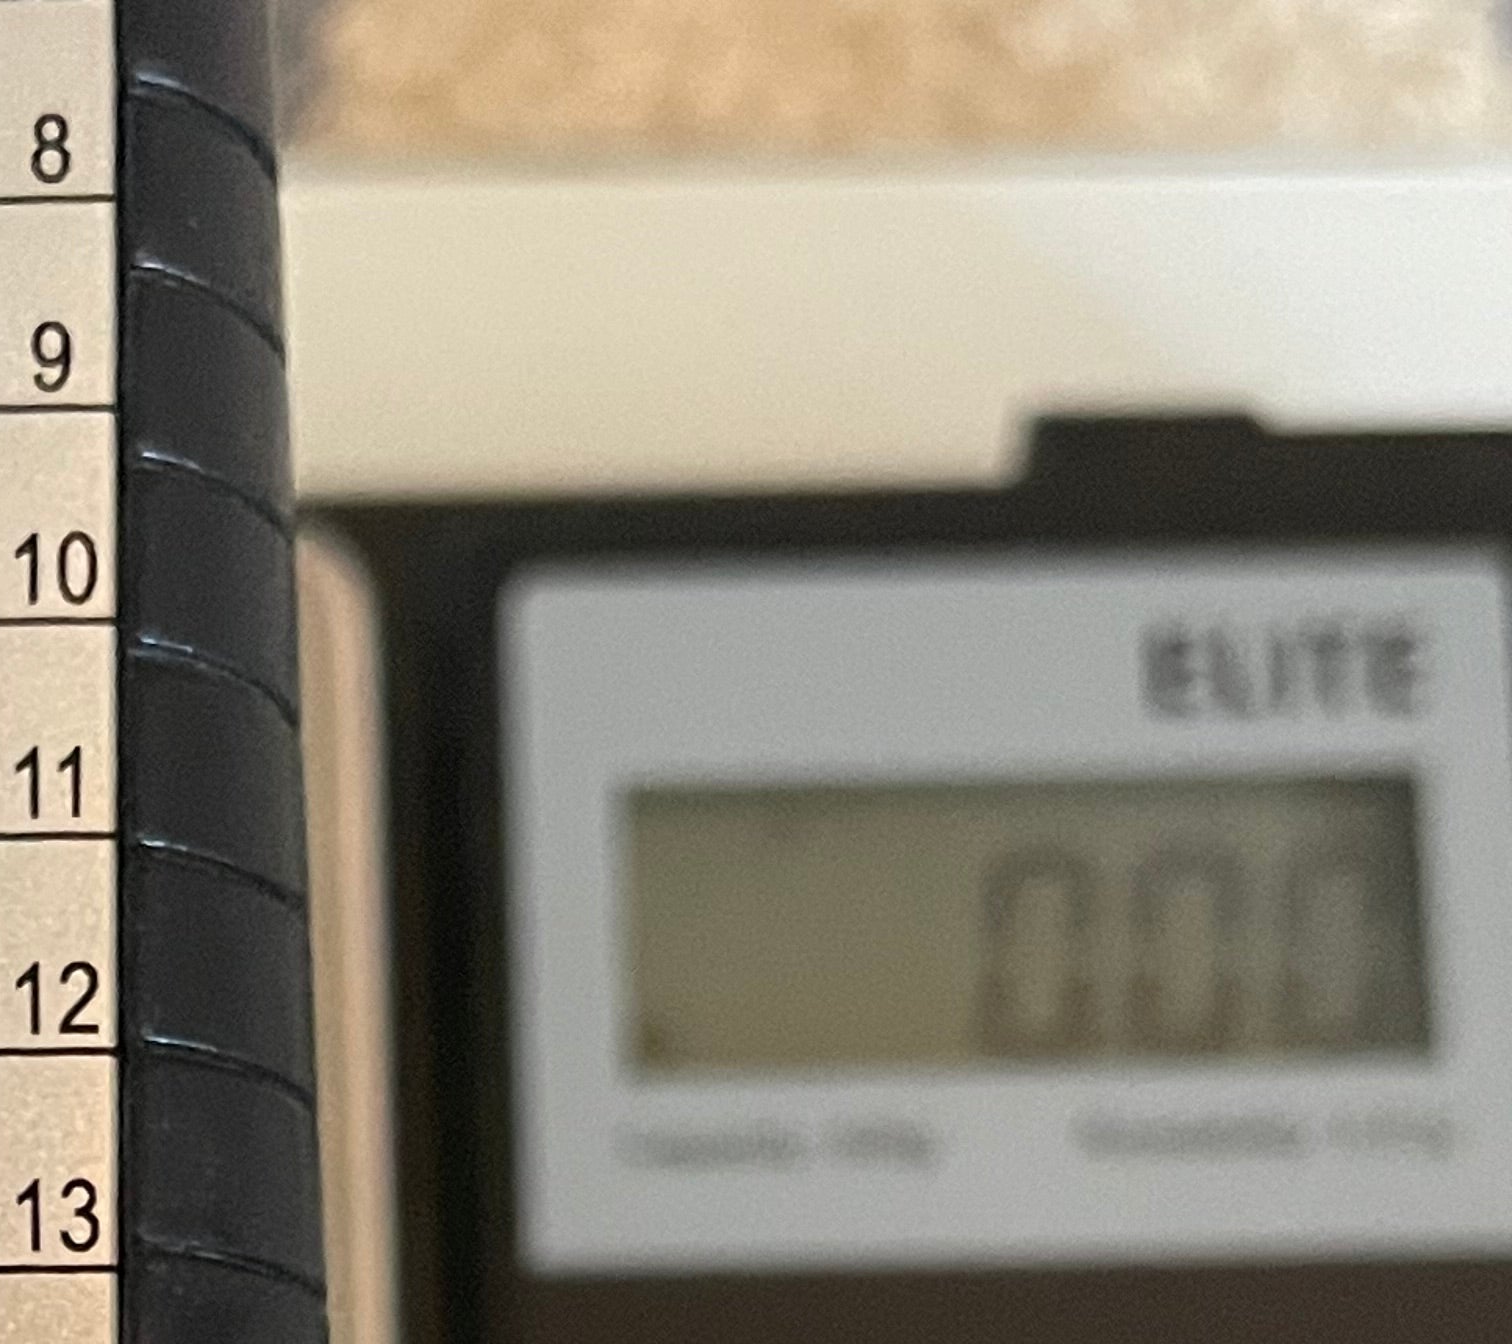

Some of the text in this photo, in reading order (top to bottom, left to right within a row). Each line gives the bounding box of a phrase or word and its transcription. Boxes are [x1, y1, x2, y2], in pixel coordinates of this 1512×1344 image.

[31, 113, 71, 184] 8
[32, 321, 72, 393] 9
[14, 531, 99, 605] 10
[1140, 615, 1426, 722] ELITE
[14, 745, 82, 819] 11
[14, 961, 100, 1036] 12
[16, 1178, 100, 1253] 13
